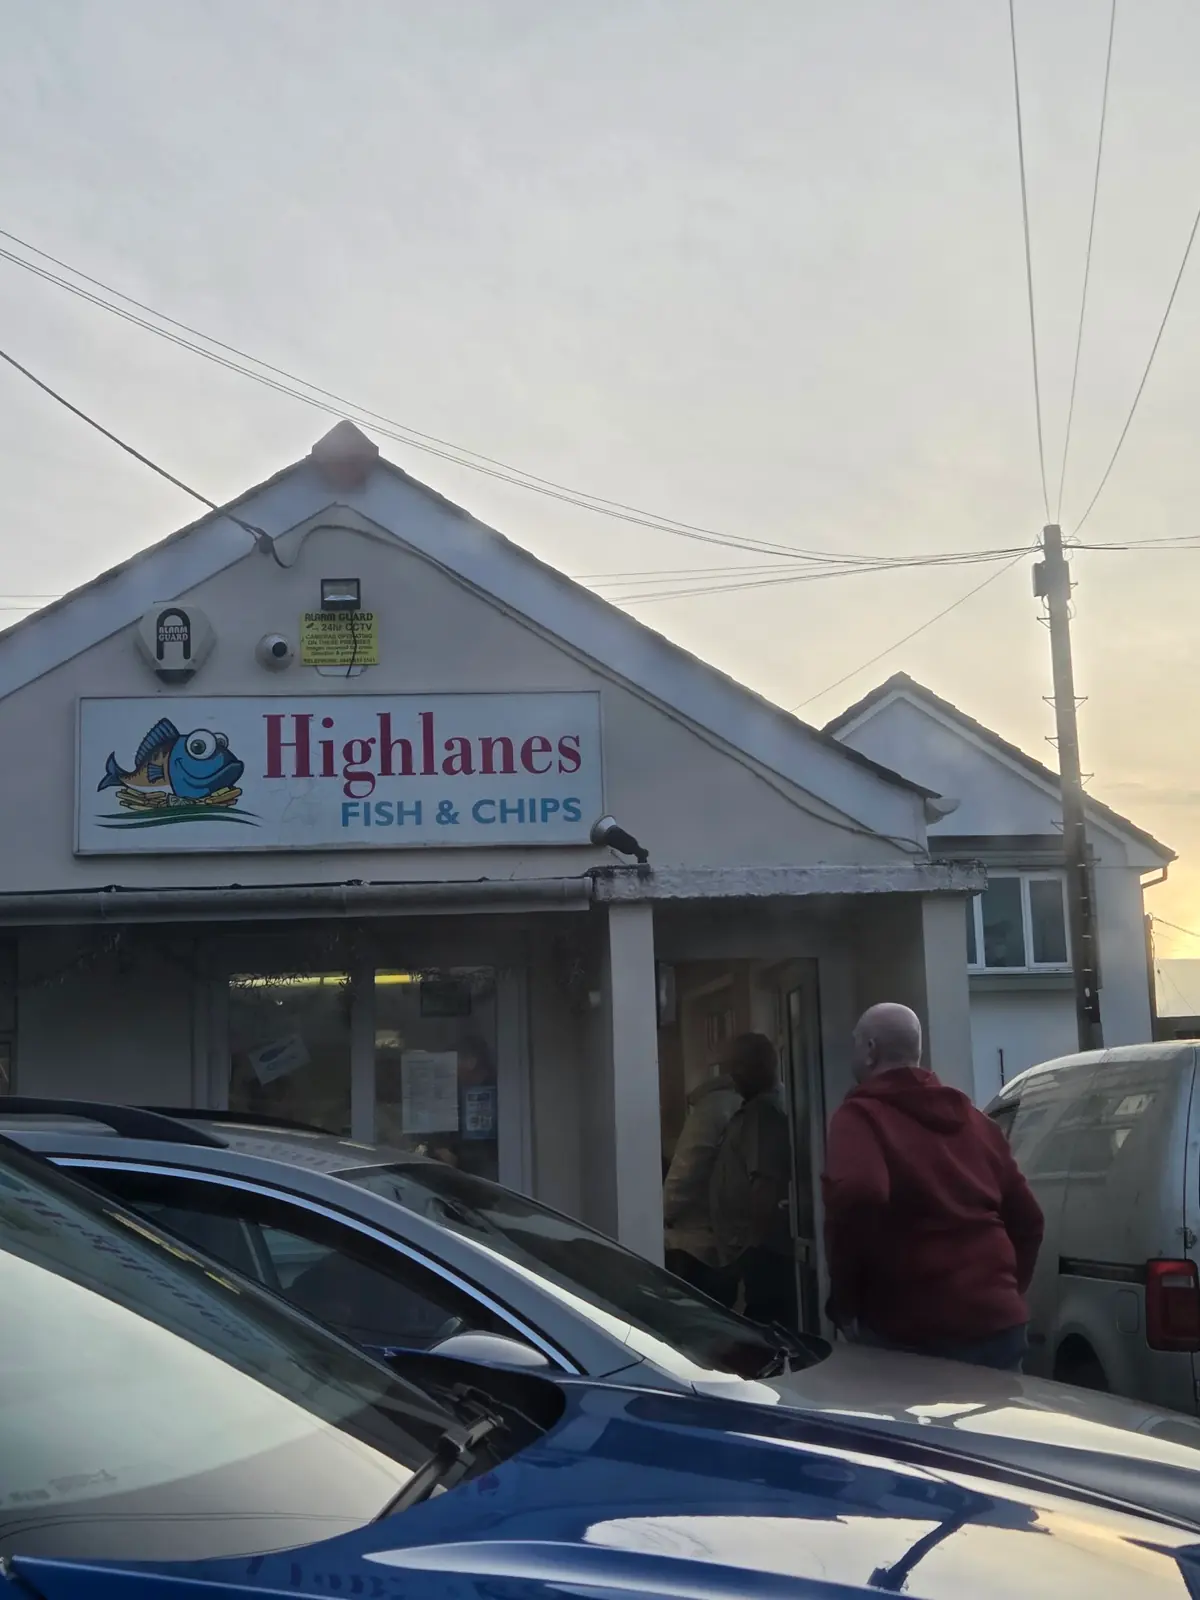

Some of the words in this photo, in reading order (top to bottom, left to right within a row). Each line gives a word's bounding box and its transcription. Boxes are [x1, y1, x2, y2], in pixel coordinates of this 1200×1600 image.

[305, 613, 336, 621] ALARM
[338, 613, 373, 621] GUARD
[159, 626, 188, 634] ALARM
[345, 623, 373, 631] CCTV
[158, 633, 188, 642] GUARD
[262, 712, 582, 799] Highlanes
[341, 801, 422, 827] FISH
[435, 800, 460, 825] &
[472, 797, 582, 824] CHIPS
